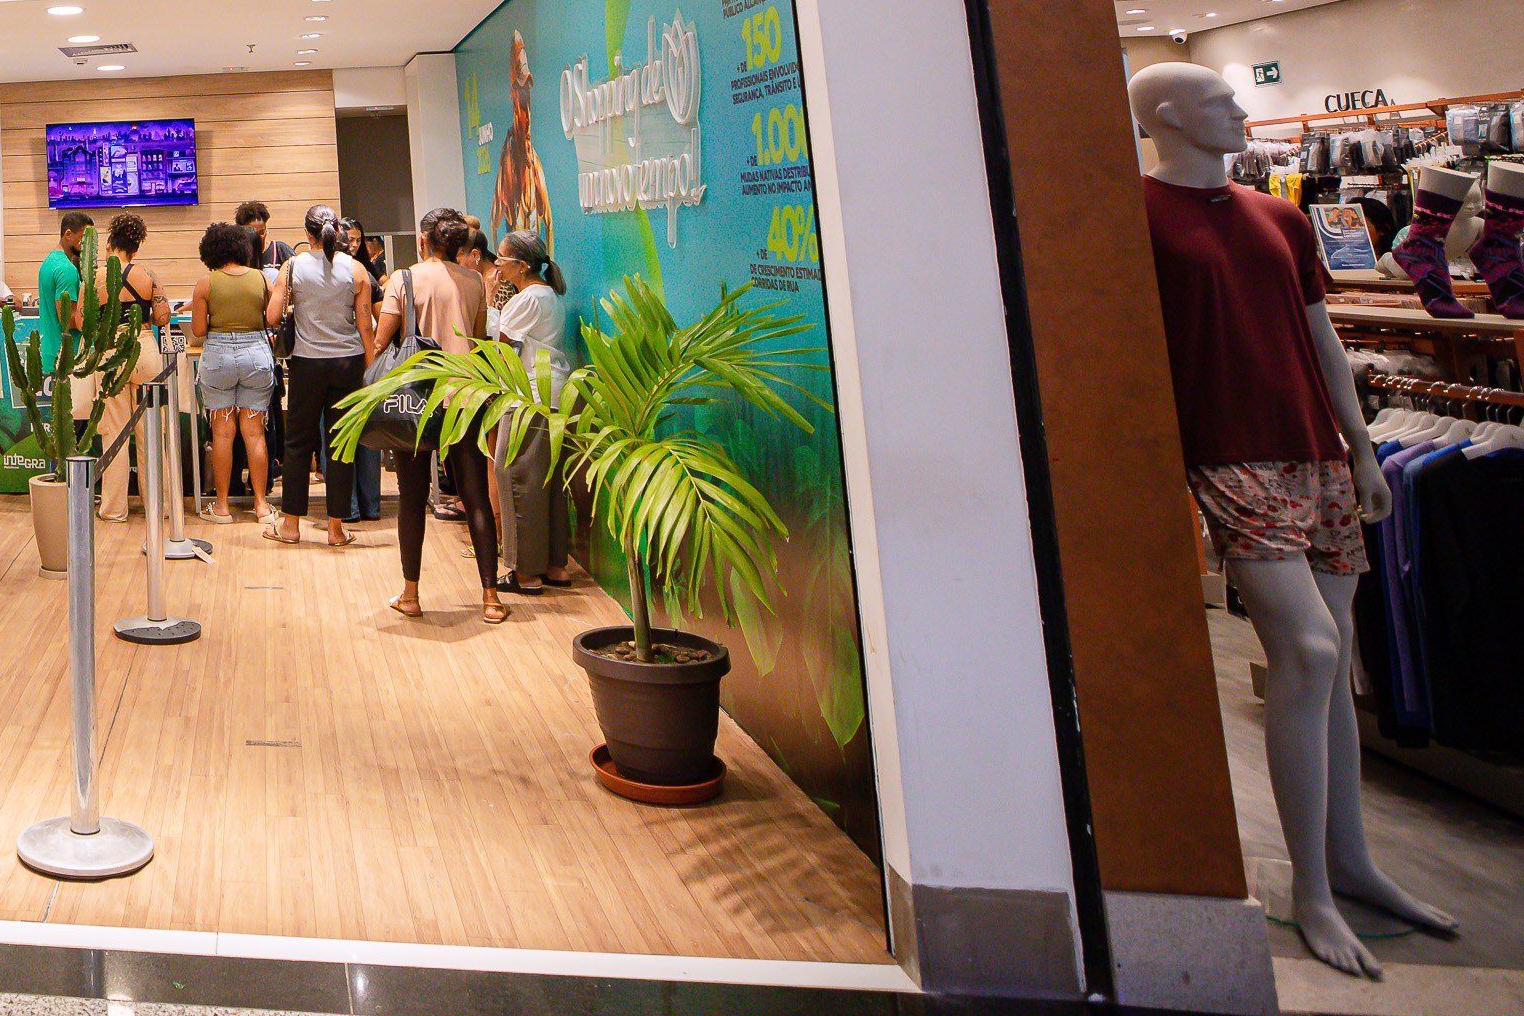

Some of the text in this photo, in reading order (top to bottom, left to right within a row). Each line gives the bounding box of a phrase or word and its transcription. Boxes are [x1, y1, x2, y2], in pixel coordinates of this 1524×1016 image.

[722, 1, 744, 20] PÚBLICO
[741, 6, 782, 71] 150
[740, 60, 748, 74] DE
[730, 70, 769, 91] PROFISSIONAIS
[764, 78, 793, 96] TRÂNSITO
[1324, 88, 1389, 113] CUECA
[759, 168, 783, 182] NATIVAS
[777, 179, 802, 194] IMPACTO
[759, 248, 768, 261] DE
[767, 204, 819, 263] 40%
[749, 263, 758, 275] DE
[757, 263, 796, 279] CRESCIMENTO
[786, 280, 800, 293] RUA
